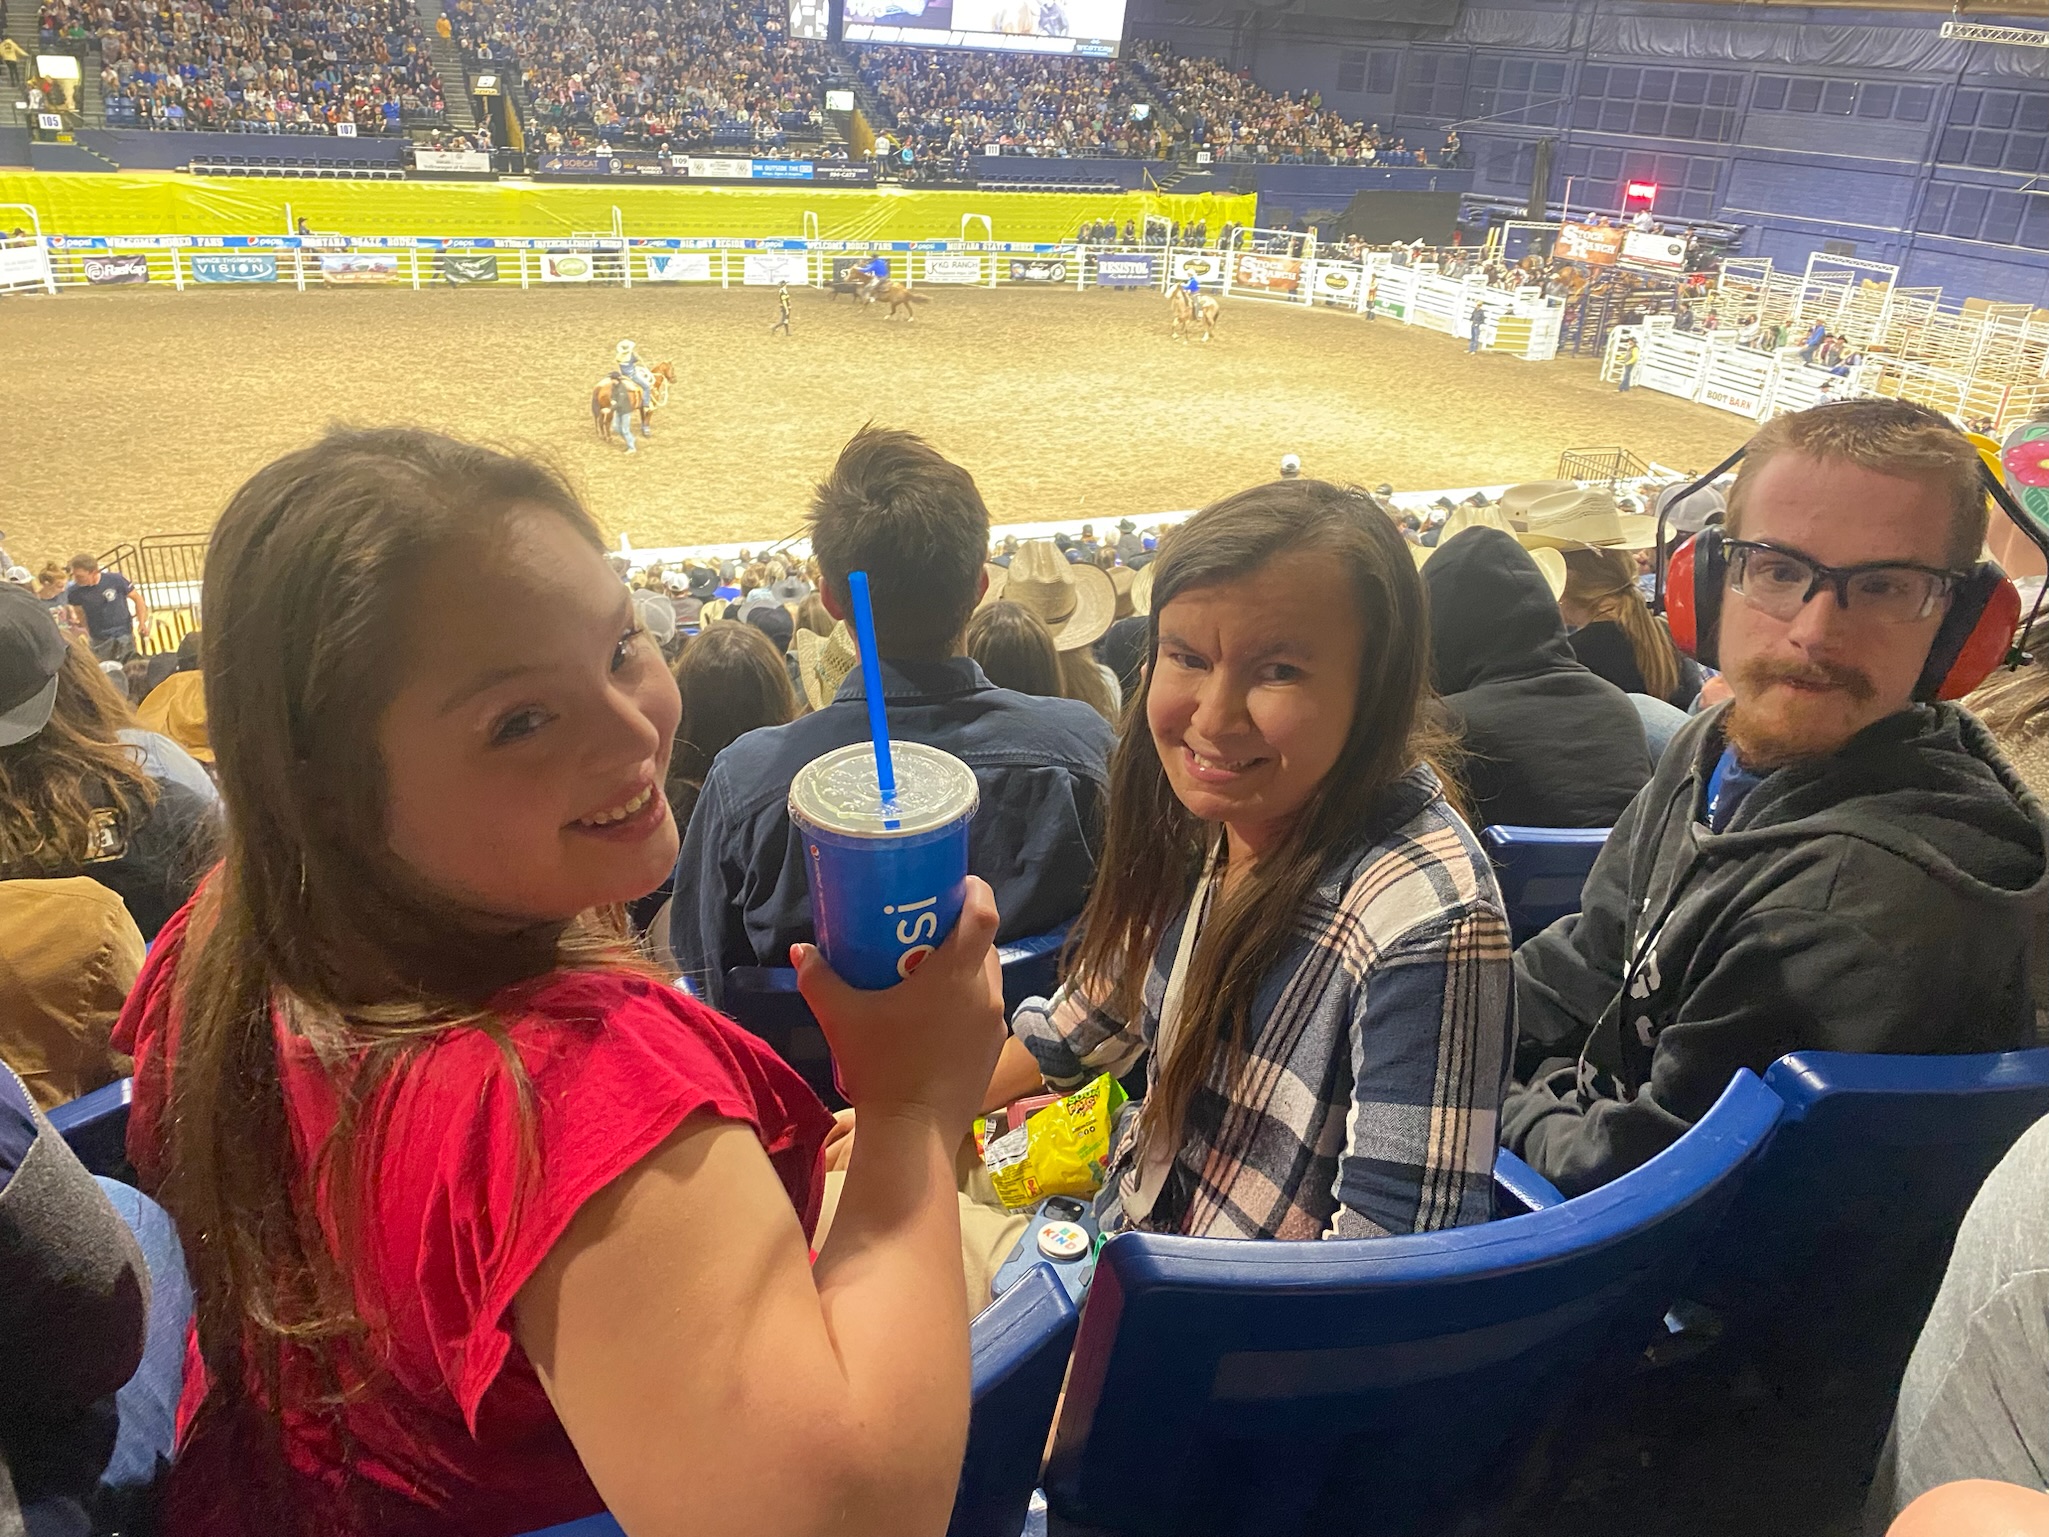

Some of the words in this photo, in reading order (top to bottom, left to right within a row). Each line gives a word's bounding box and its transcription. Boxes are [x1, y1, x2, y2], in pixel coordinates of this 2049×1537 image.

[42, 116, 59, 127] 105
[340, 125, 353, 134] 107
[988, 146, 998, 154] 111
[563, 159, 598, 168] BOBCAT
[66, 239, 91, 247] pepsi
[198, 236, 223, 247] FANS
[260, 238, 283, 247] pepsi
[351, 237, 382, 247] STATE
[453, 239, 474, 248] pepsi
[765, 241, 784, 249] pepsi
[806, 241, 844, 250] WELCOME
[873, 242, 892, 250] FANS
[197, 263, 264, 273] VISION
[951, 261, 978, 269] RANCH
[1099, 261, 1149, 274] RESISTOL
[1706, 390, 1728, 403] BOOT
[1728, 397, 1752, 410] BARN
[1068, 1088, 1100, 1105] SOUR
[1058, 1227, 1078, 1241] BE
[1042, 1227, 1077, 1251] KIND
